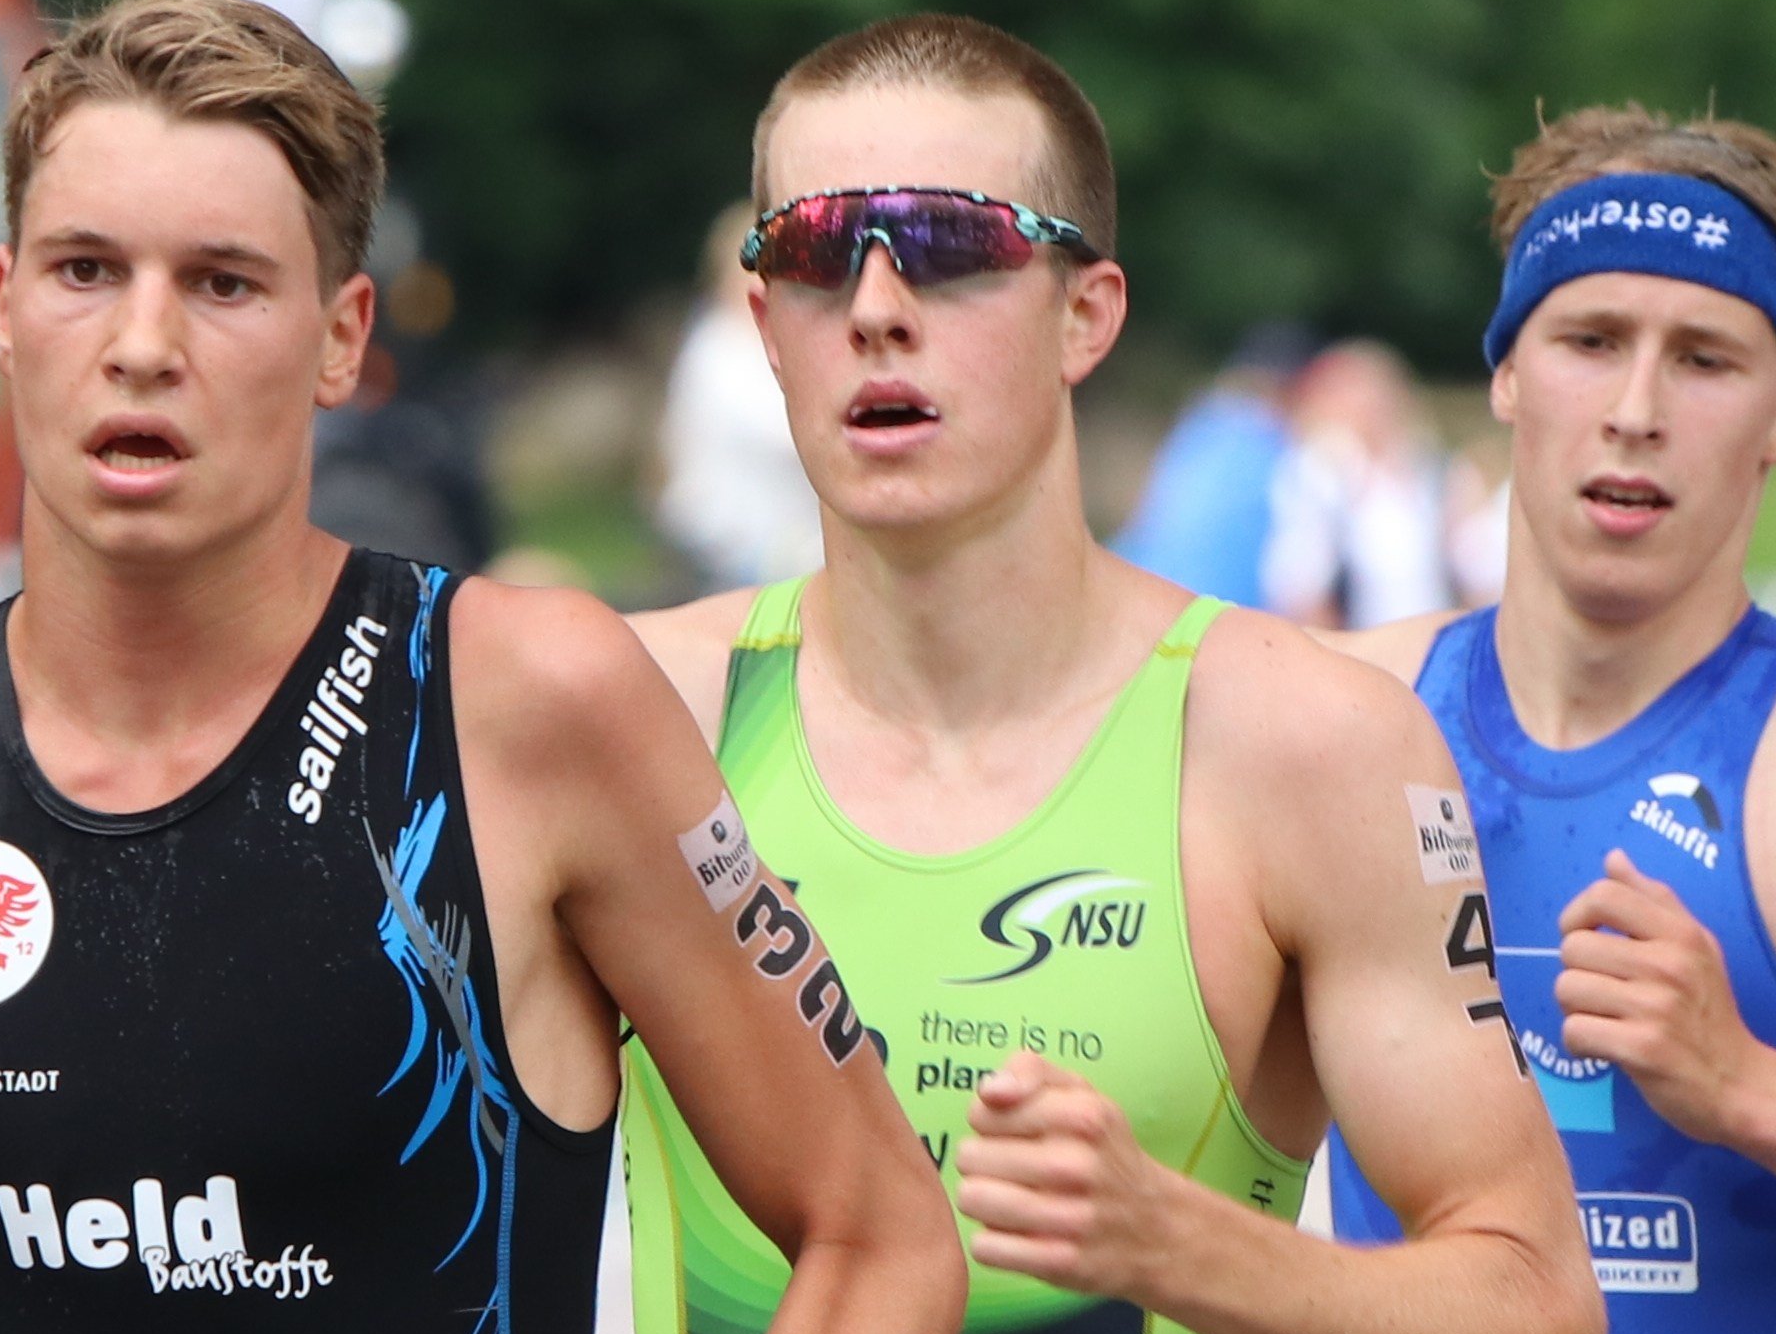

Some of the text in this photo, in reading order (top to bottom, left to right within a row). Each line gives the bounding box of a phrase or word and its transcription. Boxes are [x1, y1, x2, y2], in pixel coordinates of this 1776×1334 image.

[288, 615, 388, 826] sailfish
[1629, 799, 1720, 870] skinfit
[16, 942, 35, 956] 12
[1060, 901, 1147, 948] NSU
[735, 880, 865, 1068] 32
[921, 1010, 1008, 1049] there
[1020, 1016, 1047, 1054] is
[1058, 1028, 1103, 1062] no
[143, 1244, 334, 1299] Baustoffe
